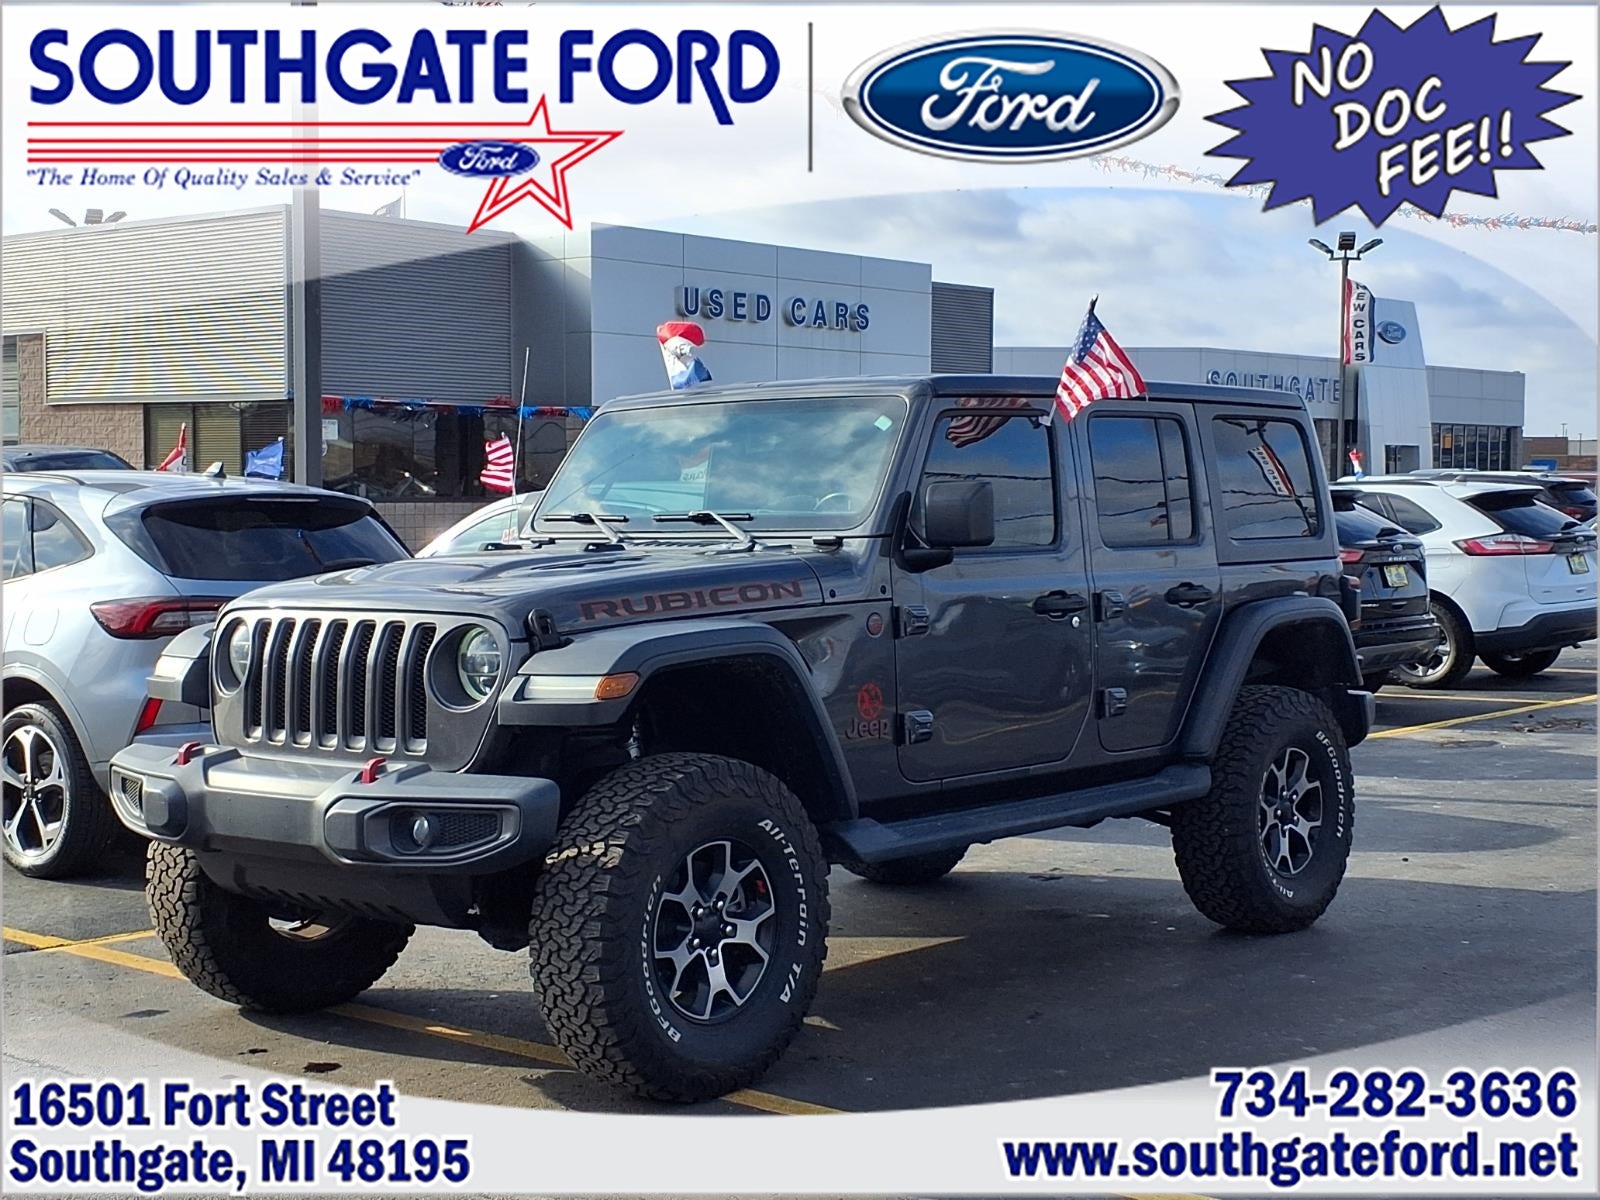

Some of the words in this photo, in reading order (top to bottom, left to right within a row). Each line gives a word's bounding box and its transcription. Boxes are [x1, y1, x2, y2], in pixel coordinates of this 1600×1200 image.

[678, 286, 772, 323] USED
[787, 296, 871, 332] CARS
[1352, 319, 1366, 361] CARS
[580, 580, 803, 620] RUBICON
[845, 718, 889, 740] Jeep
[1316, 730, 1345, 838] BFGoodrich
[757, 818, 809, 947] All-Terrain
[640, 874, 682, 1044] BFGoodrich
[778, 962, 804, 1004] T/A
